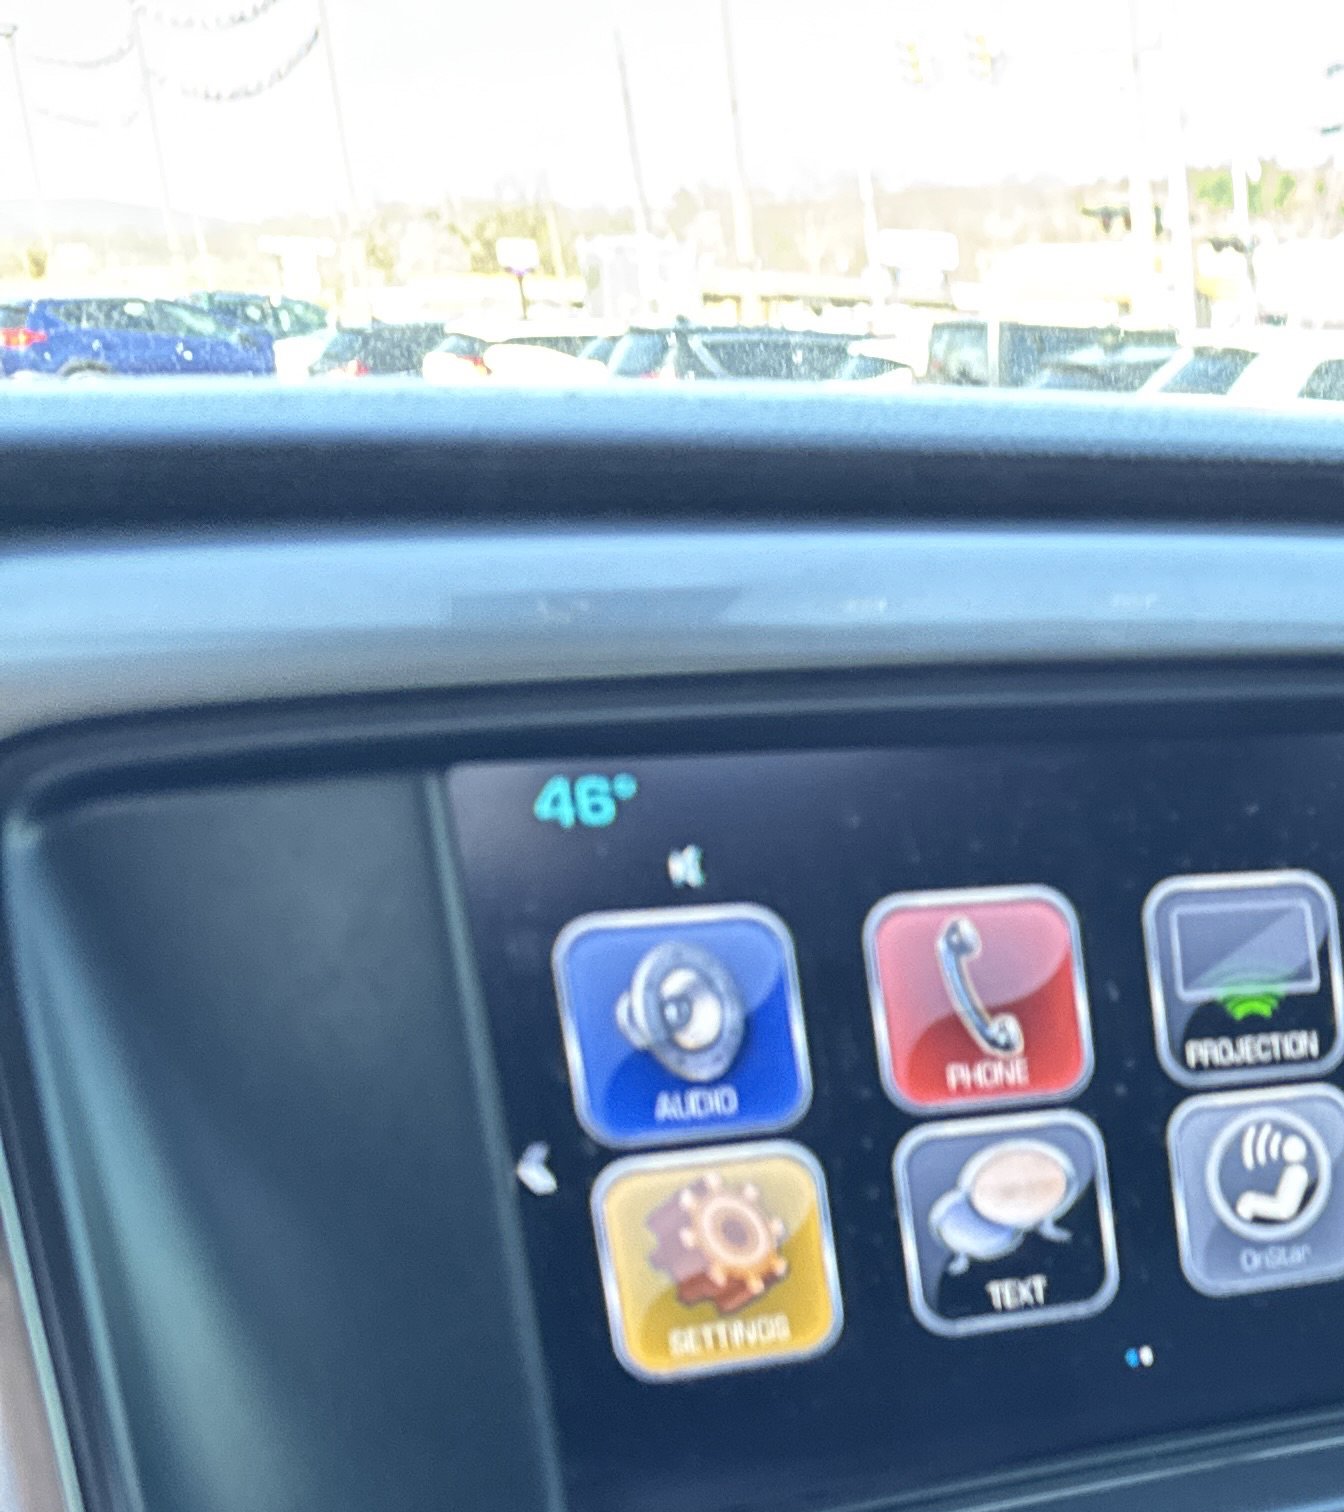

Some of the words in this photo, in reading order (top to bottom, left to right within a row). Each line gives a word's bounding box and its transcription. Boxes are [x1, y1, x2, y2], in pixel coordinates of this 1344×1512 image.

[1185, 1031, 1320, 1068] PROJECTION
[946, 1056, 1029, 1091] PHONE
[654, 1083, 738, 1123] AUDIO
[986, 1273, 1046, 1309] TEXT
[668, 1313, 790, 1356] SETTINGS
